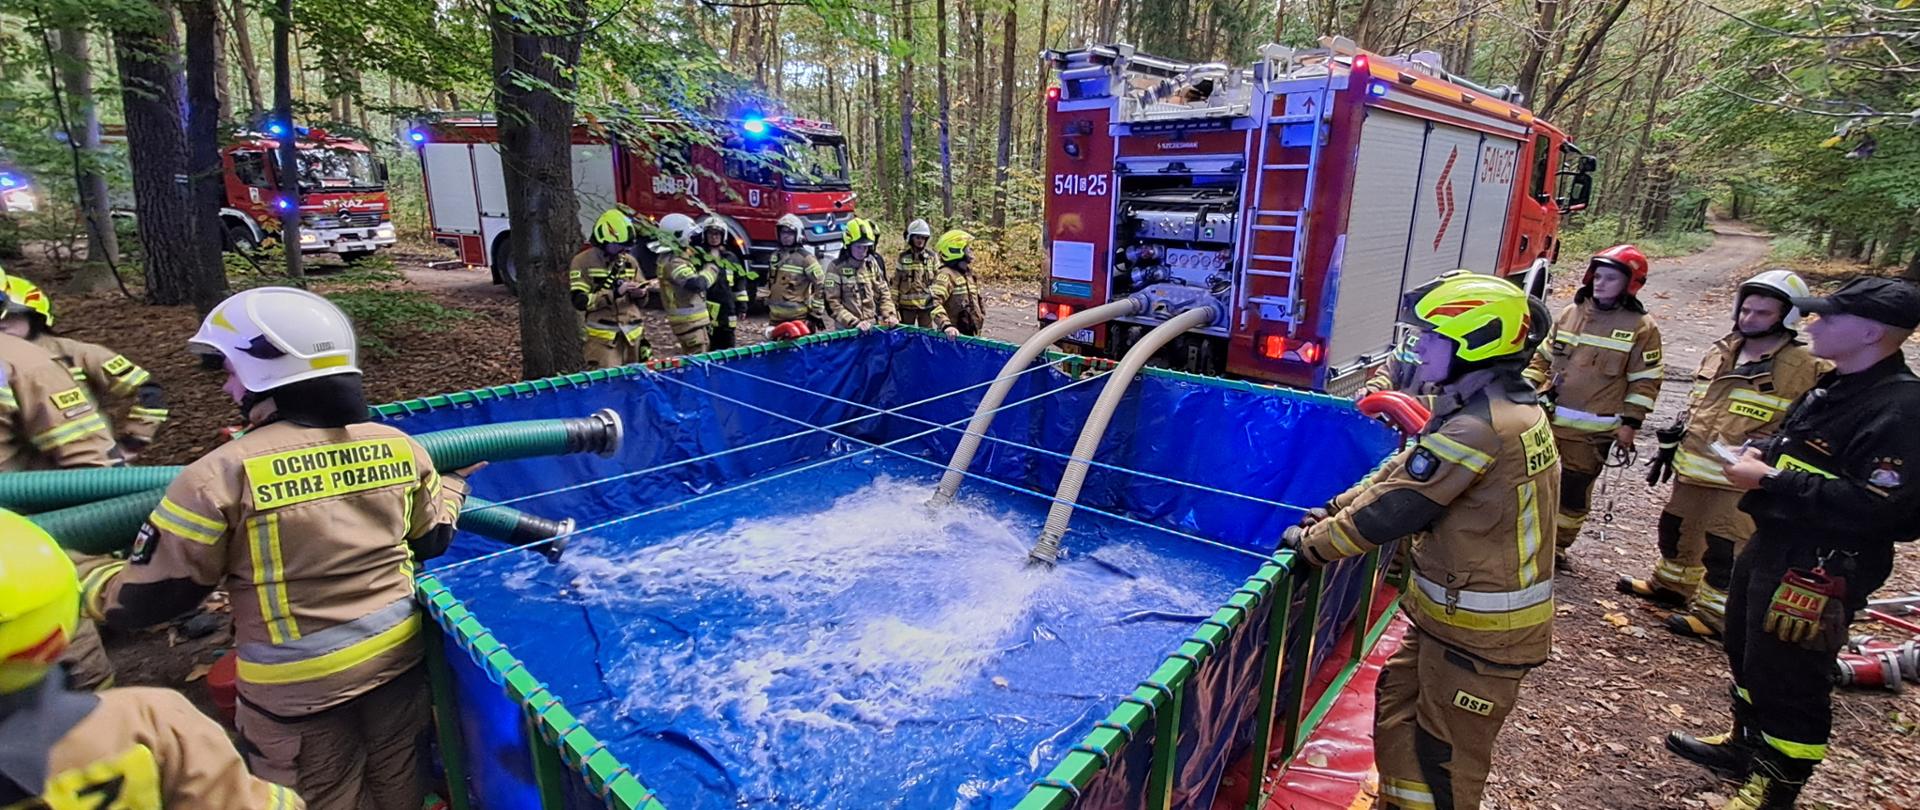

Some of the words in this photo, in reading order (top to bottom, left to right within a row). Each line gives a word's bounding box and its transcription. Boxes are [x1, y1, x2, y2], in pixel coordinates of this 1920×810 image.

[272, 443, 393, 477] OCHOTNICZA
[330, 460, 414, 489] POŻARNA
[1460, 695, 1489, 712] OSP
